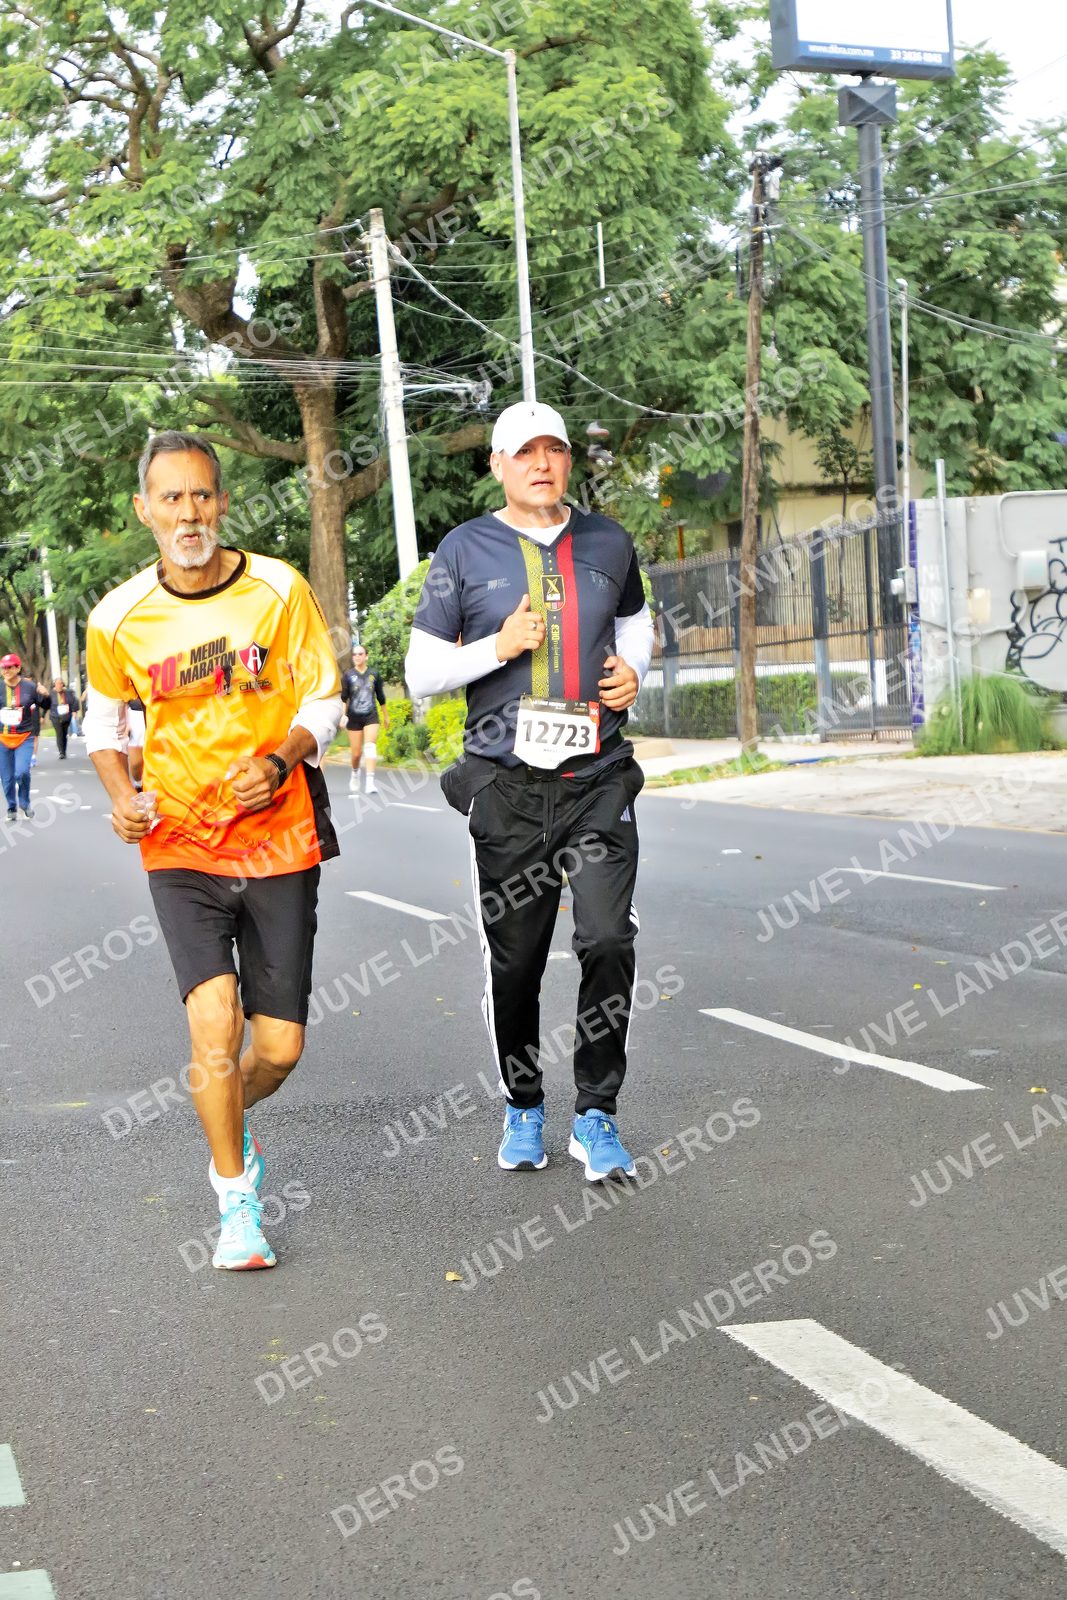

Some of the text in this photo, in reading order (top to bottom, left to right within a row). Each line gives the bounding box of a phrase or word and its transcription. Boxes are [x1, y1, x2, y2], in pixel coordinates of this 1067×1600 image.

[190, 636, 227, 665] MEDIO
[180, 650, 236, 686] MARATON
[523, 719, 590, 748] 12723
